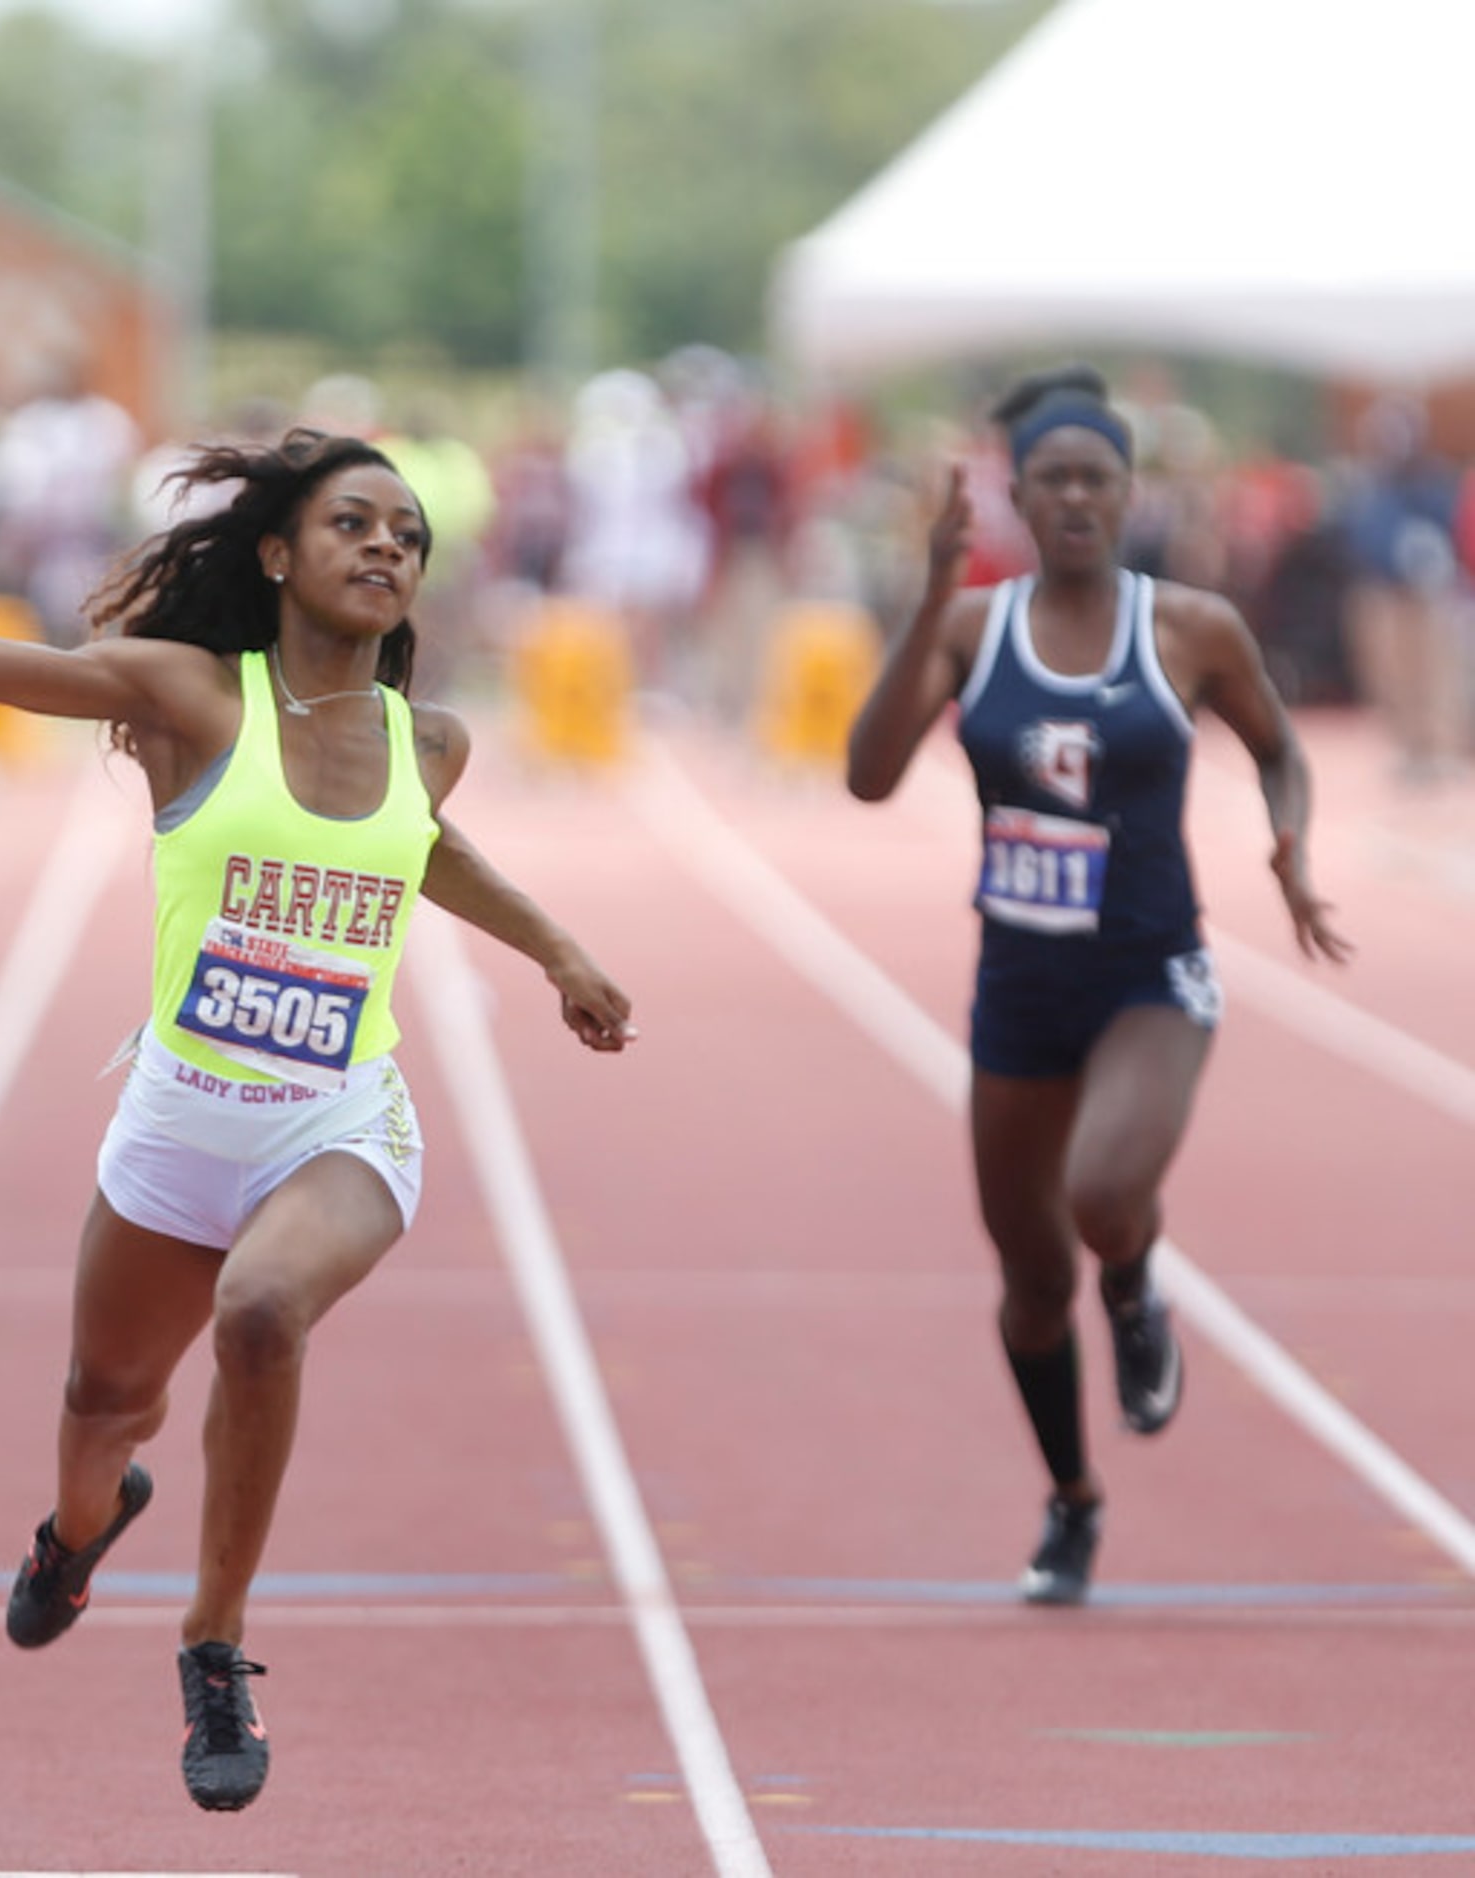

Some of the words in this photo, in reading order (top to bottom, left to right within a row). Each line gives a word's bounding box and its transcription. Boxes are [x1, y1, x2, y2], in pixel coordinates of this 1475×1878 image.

[220, 854, 406, 948] CARTER
[195, 966, 352, 1056] 3505
[175, 1062, 233, 1098] LADY
